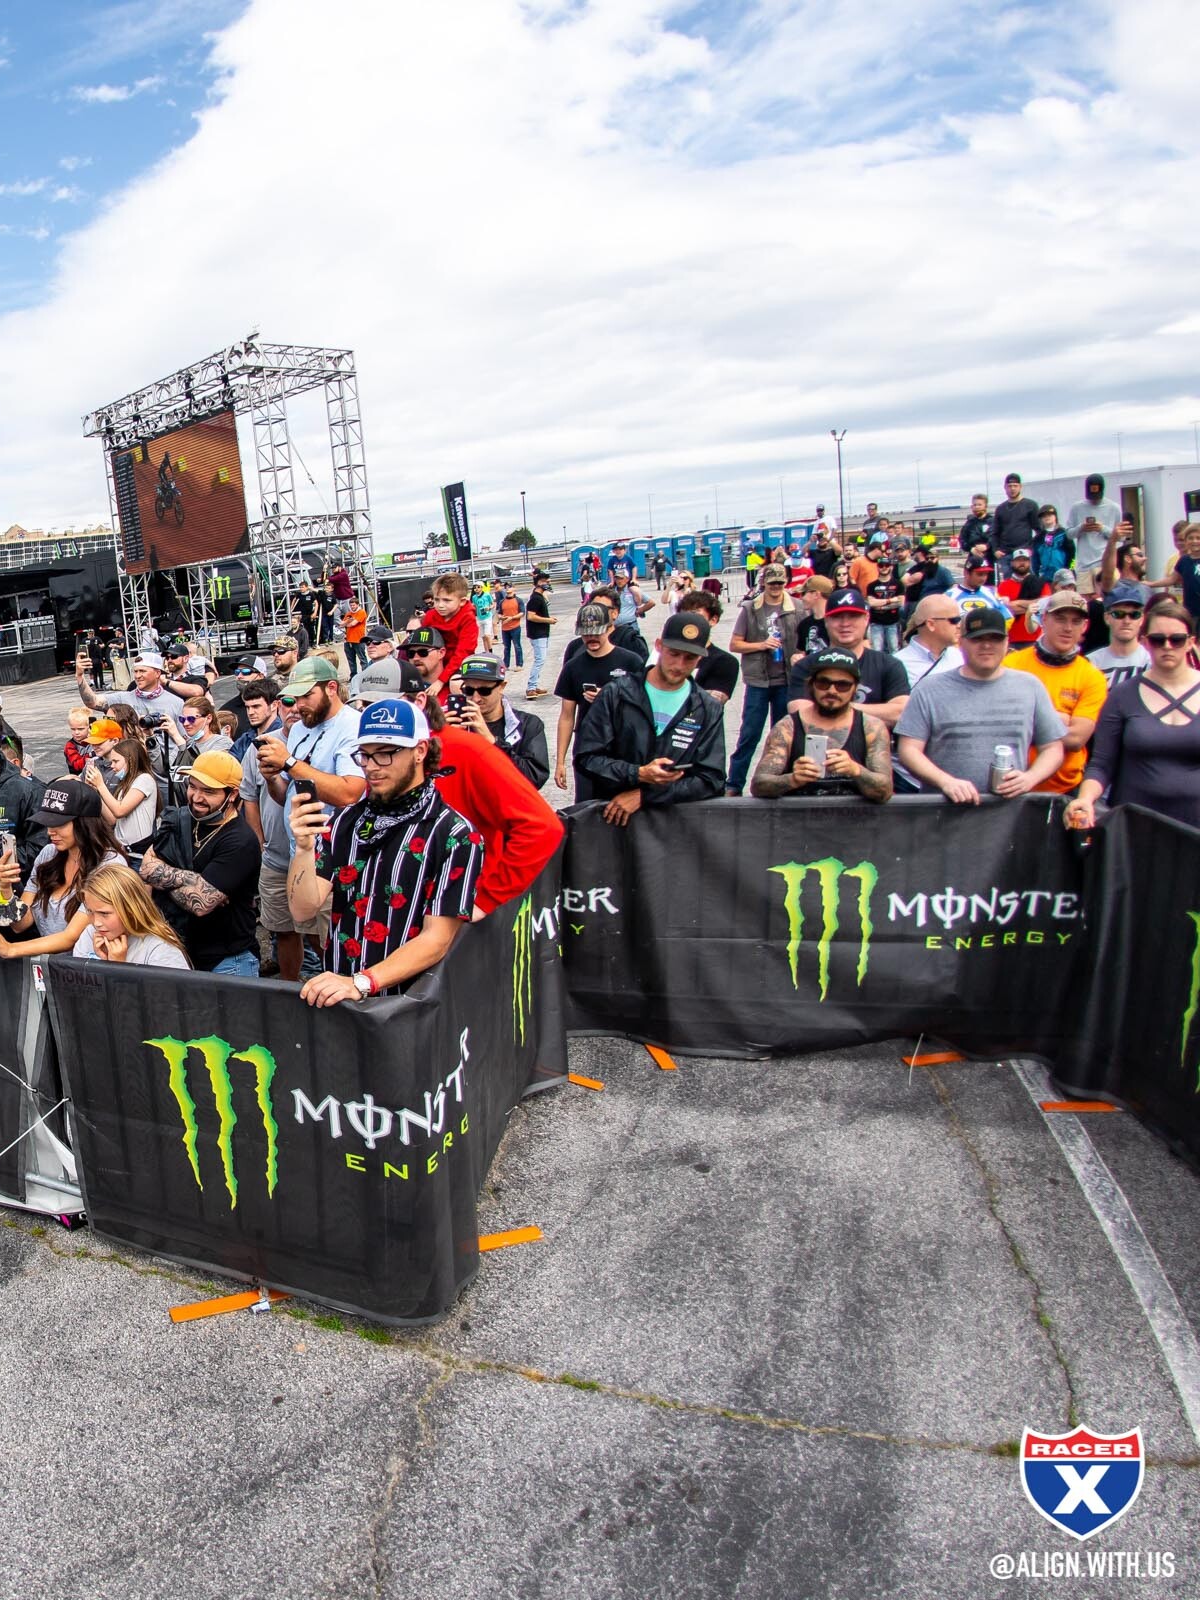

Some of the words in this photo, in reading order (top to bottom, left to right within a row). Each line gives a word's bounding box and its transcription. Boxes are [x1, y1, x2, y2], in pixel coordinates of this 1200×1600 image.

[453, 496, 469, 547] Kawasaki
[50, 789, 69, 803] BIKE
[887, 886, 1087, 931] MONSTE
[926, 931, 1072, 950] ENERGY
[345, 1112, 469, 1180] ENERG
